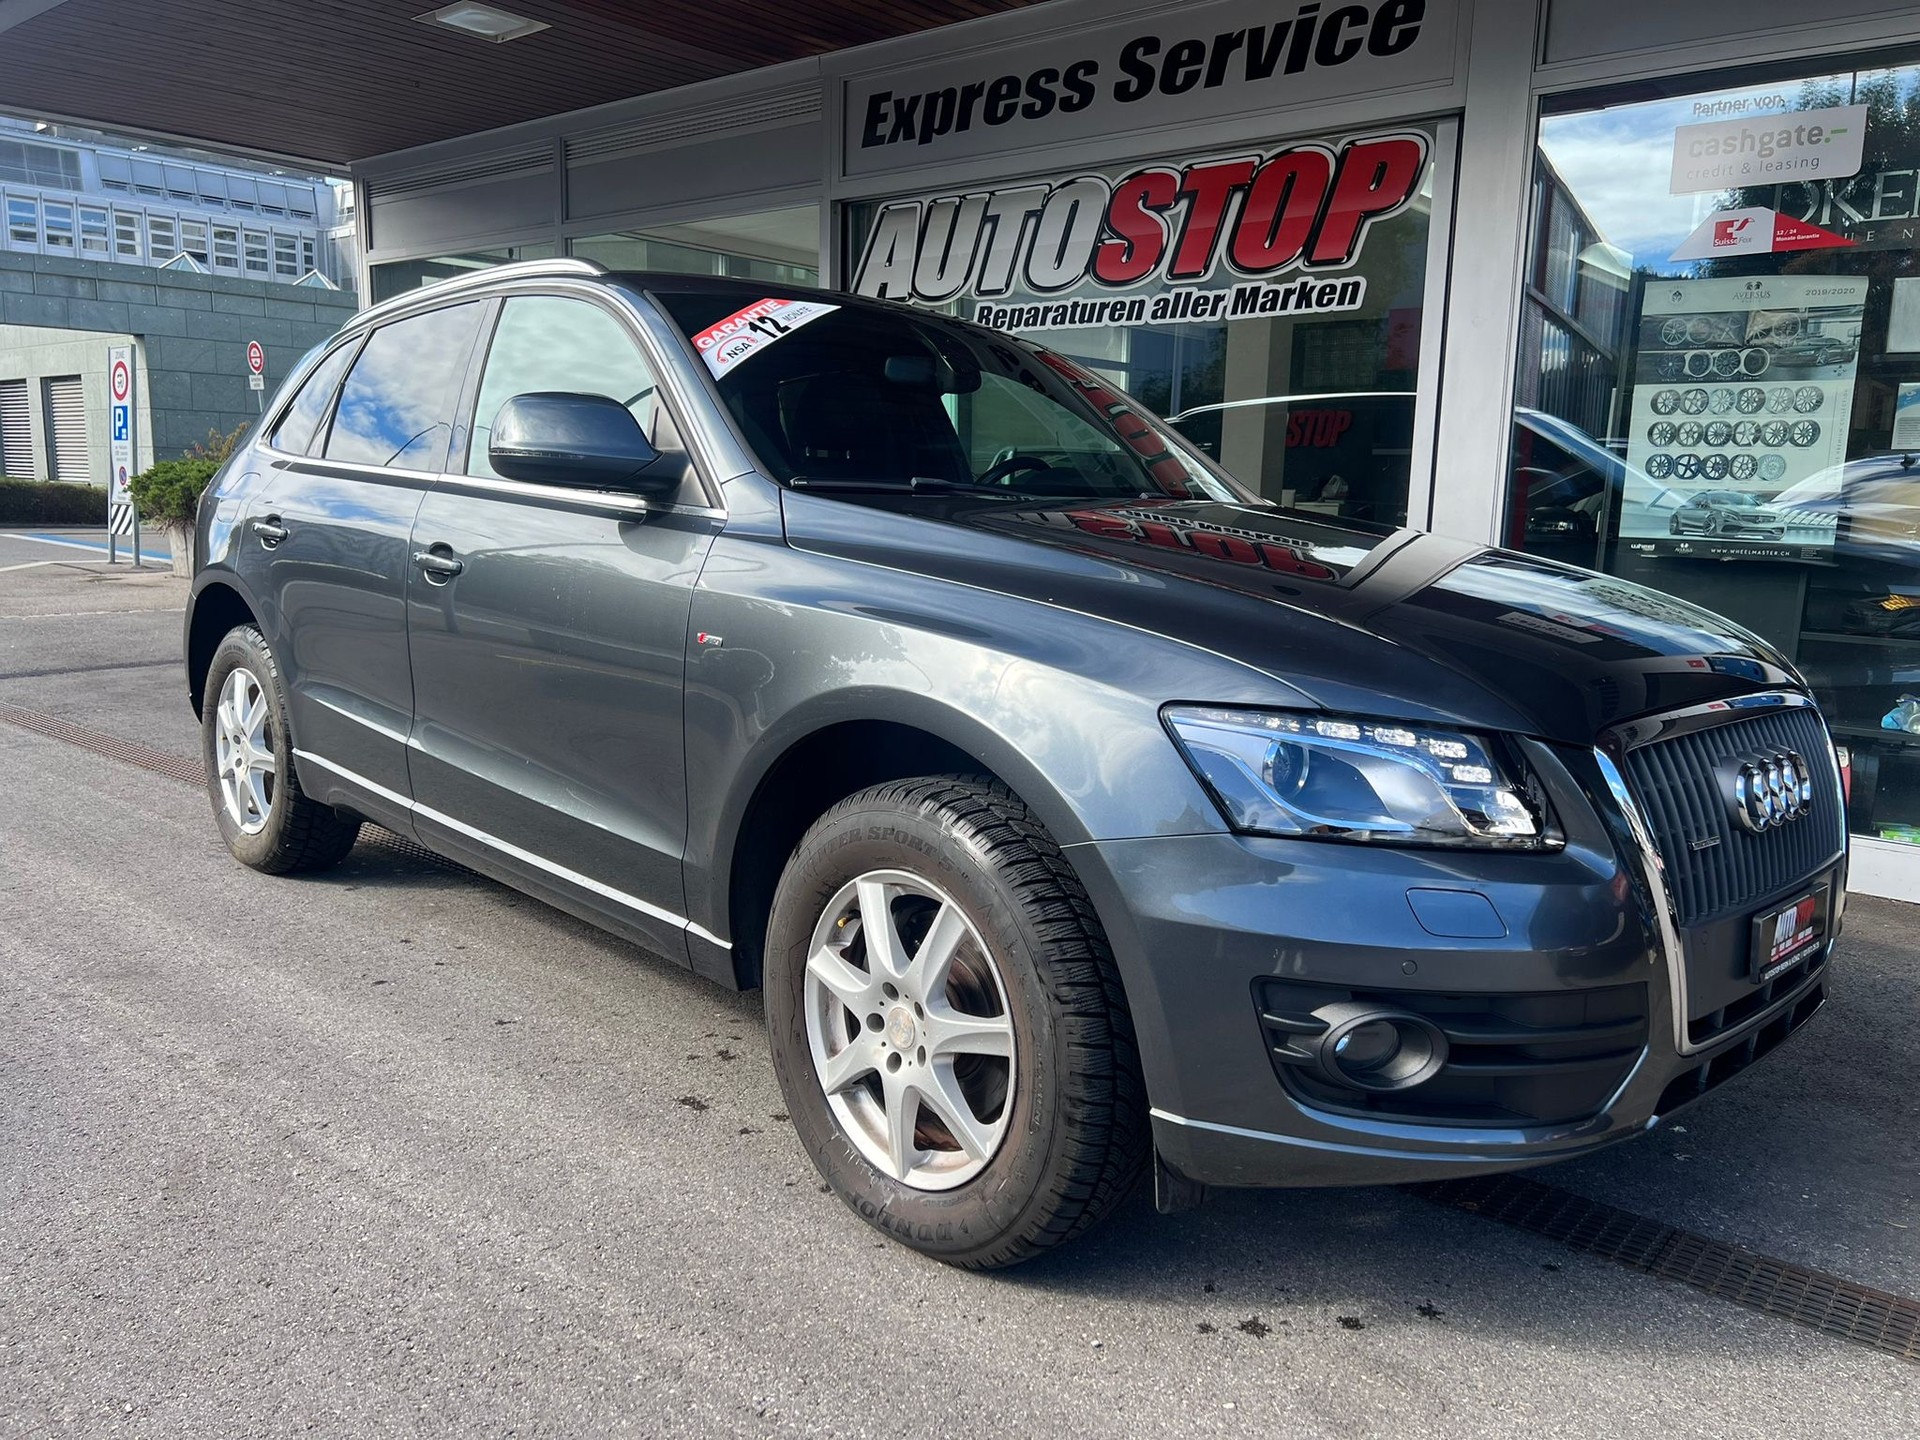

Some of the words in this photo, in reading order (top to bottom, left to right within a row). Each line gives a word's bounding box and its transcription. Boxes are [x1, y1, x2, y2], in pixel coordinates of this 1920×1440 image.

[861, 59, 1099, 149] Express
[1113, 0, 1426, 103] Service
[1693, 98, 1749, 116] Partner
[1754, 94, 1783, 109] von
[1687, 162, 1733, 180] credit
[1741, 162, 1752, 174] &
[1759, 156, 1821, 172] leasing
[852, 131, 1433, 305] AUTOSTOP
[978, 298, 1146, 332] Reparaturen
[1151, 291, 1227, 321] aller
[1232, 278, 1362, 316] Marken
[1805, 287, 1856, 297] 2019/2020
[696, 300, 783, 350] GARANTIE
[749, 315, 793, 339] 12
[782, 306, 812, 323] MONATE
[725, 341, 752, 359] NSA
[1285, 410, 1353, 448] STOP
[1710, 547, 1791, 557] WWW.WHEELMASTER.CH
[867, 826, 938, 857] SPORT
